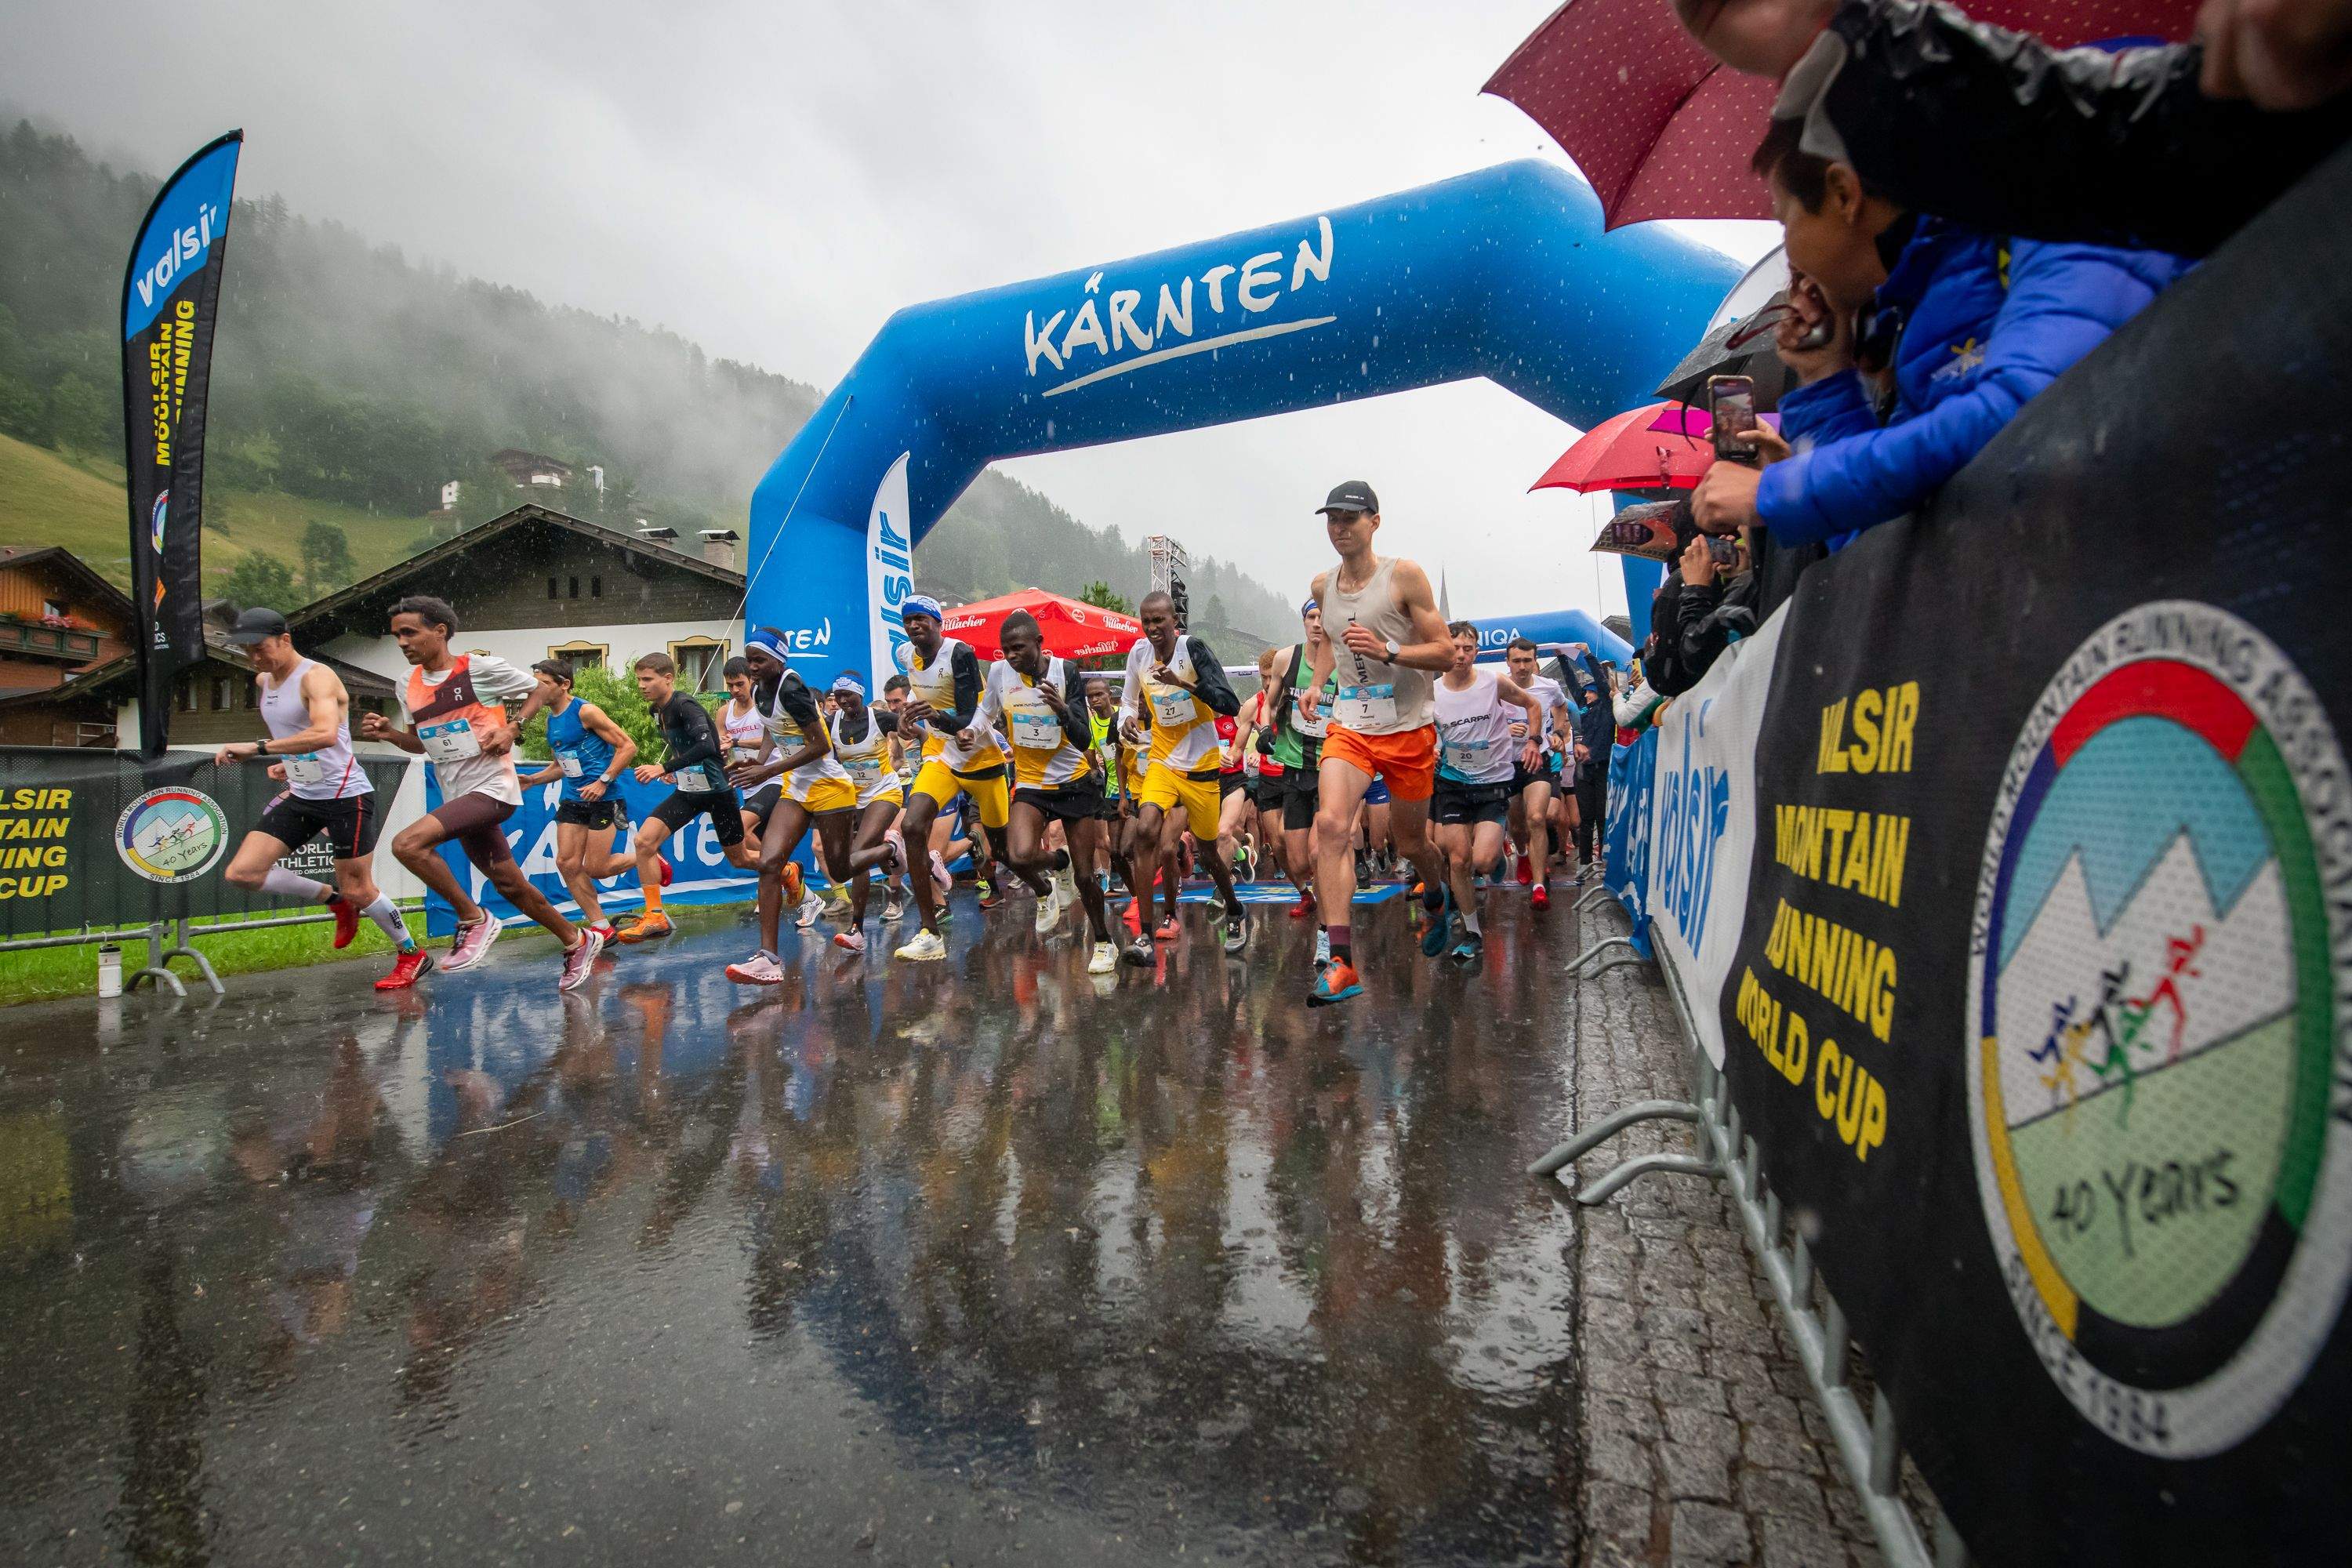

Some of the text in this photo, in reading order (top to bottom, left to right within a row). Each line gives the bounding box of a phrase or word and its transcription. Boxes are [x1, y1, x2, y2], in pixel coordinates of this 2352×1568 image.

[1025, 216, 1334, 377] KÄRNTEN
[176, 300, 195, 424] NNING
[1102, 615, 1138, 634] Villacher
[1348, 612, 1369, 684] MERL
[1165, 706, 1176, 717] 27
[1362, 704, 1369, 714] 7
[1450, 714, 1490, 728] SCARPA
[1033, 728, 1040, 737] 3
[116, 786, 228, 838] WORLD MOUNTAIN RUNNING ASSOCIATION
[0, 845, 68, 869] ING
[162, 842, 209, 867] 40 Years
[292, 842, 334, 856] ORLD
[149, 870, 201, 884] SINCE 1984
[1815, 1037, 1887, 1163] CUP
[2051, 1147, 2240, 1258] 40 Years
[2087, 1374, 2172, 1445] 1984
